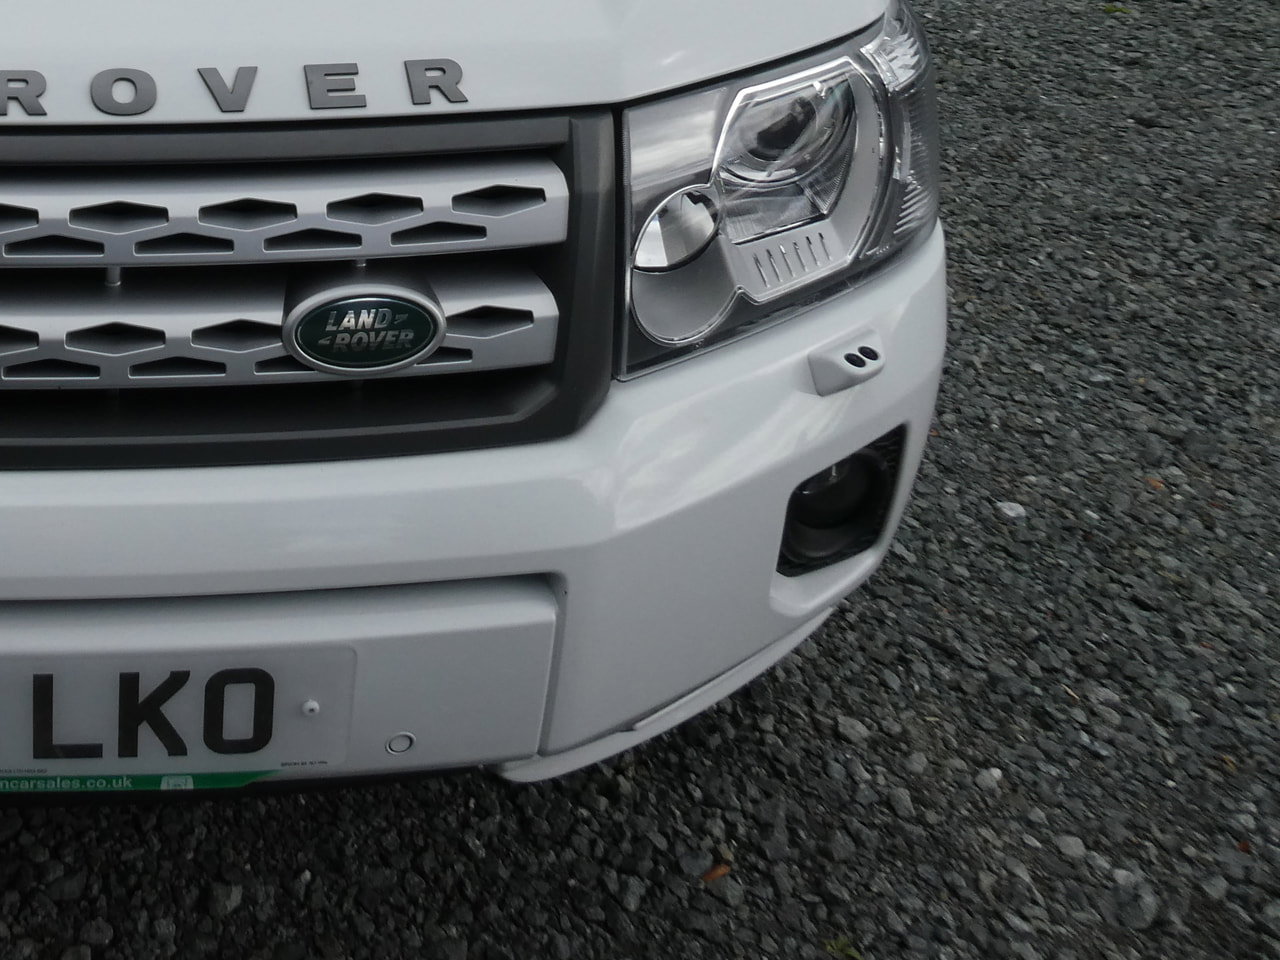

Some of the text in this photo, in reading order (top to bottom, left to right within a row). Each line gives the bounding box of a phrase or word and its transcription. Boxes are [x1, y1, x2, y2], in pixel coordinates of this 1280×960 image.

[325, 308, 393, 332] LAND
[332, 328, 415, 353] ROVER
[32, 667, 276, 759] LKO
